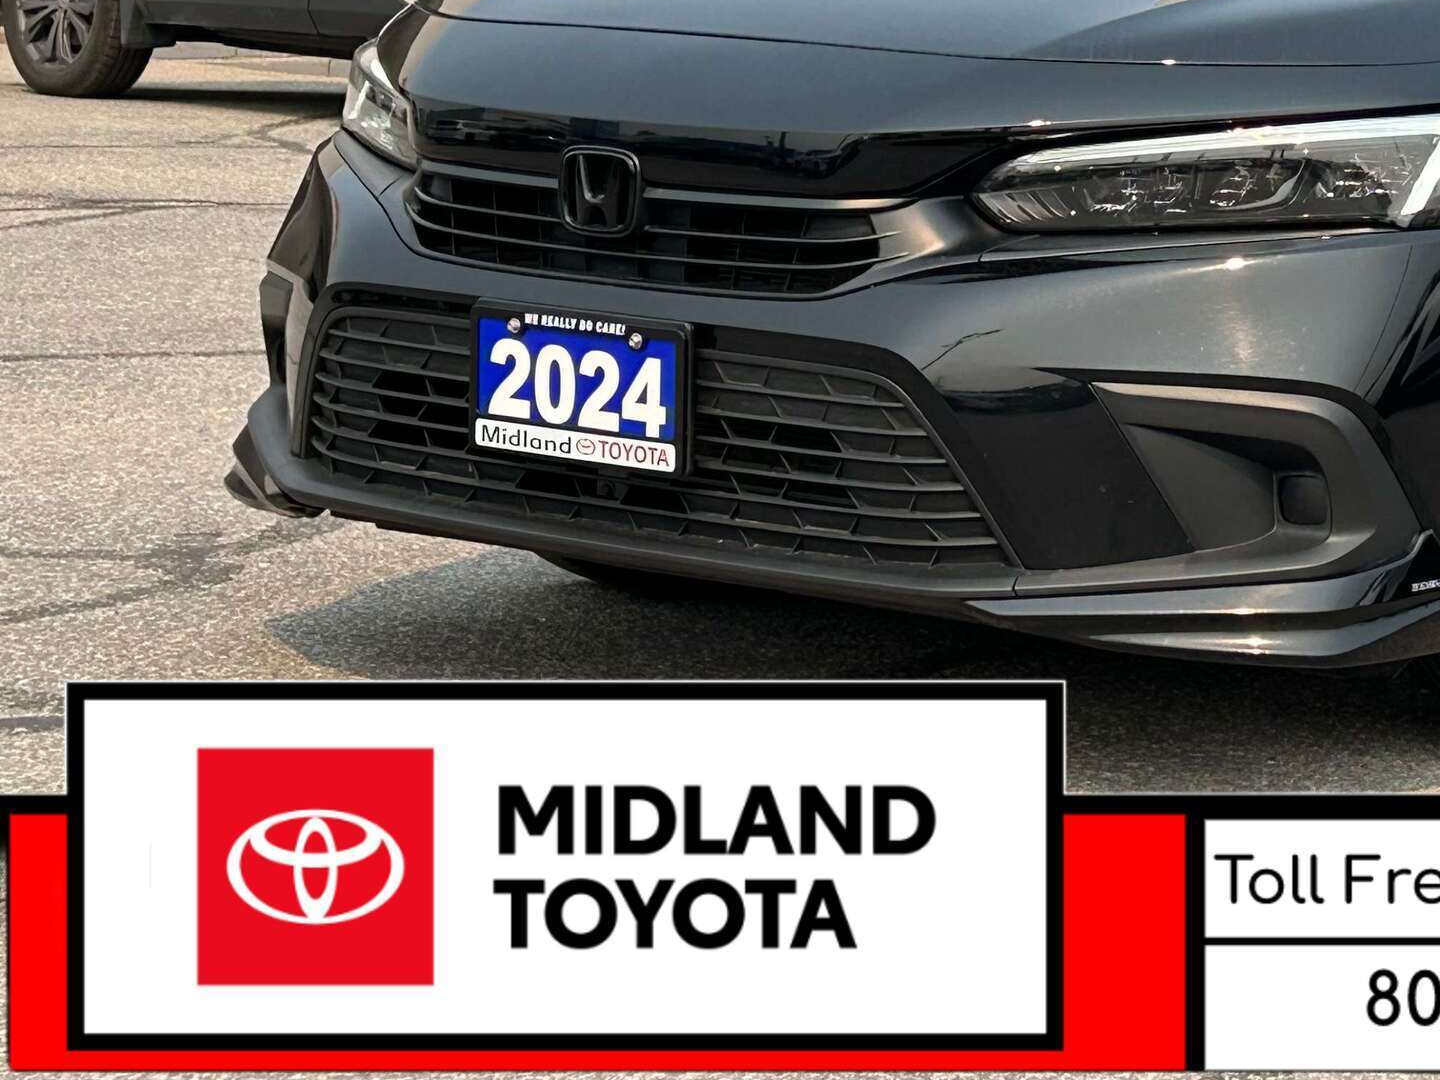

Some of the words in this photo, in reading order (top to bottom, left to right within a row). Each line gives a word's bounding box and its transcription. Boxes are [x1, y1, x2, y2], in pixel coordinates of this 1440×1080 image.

[487, 338, 667, 439] 2024
[481, 425, 572, 454] Midland
[598, 440, 670, 467] TOYOTA
